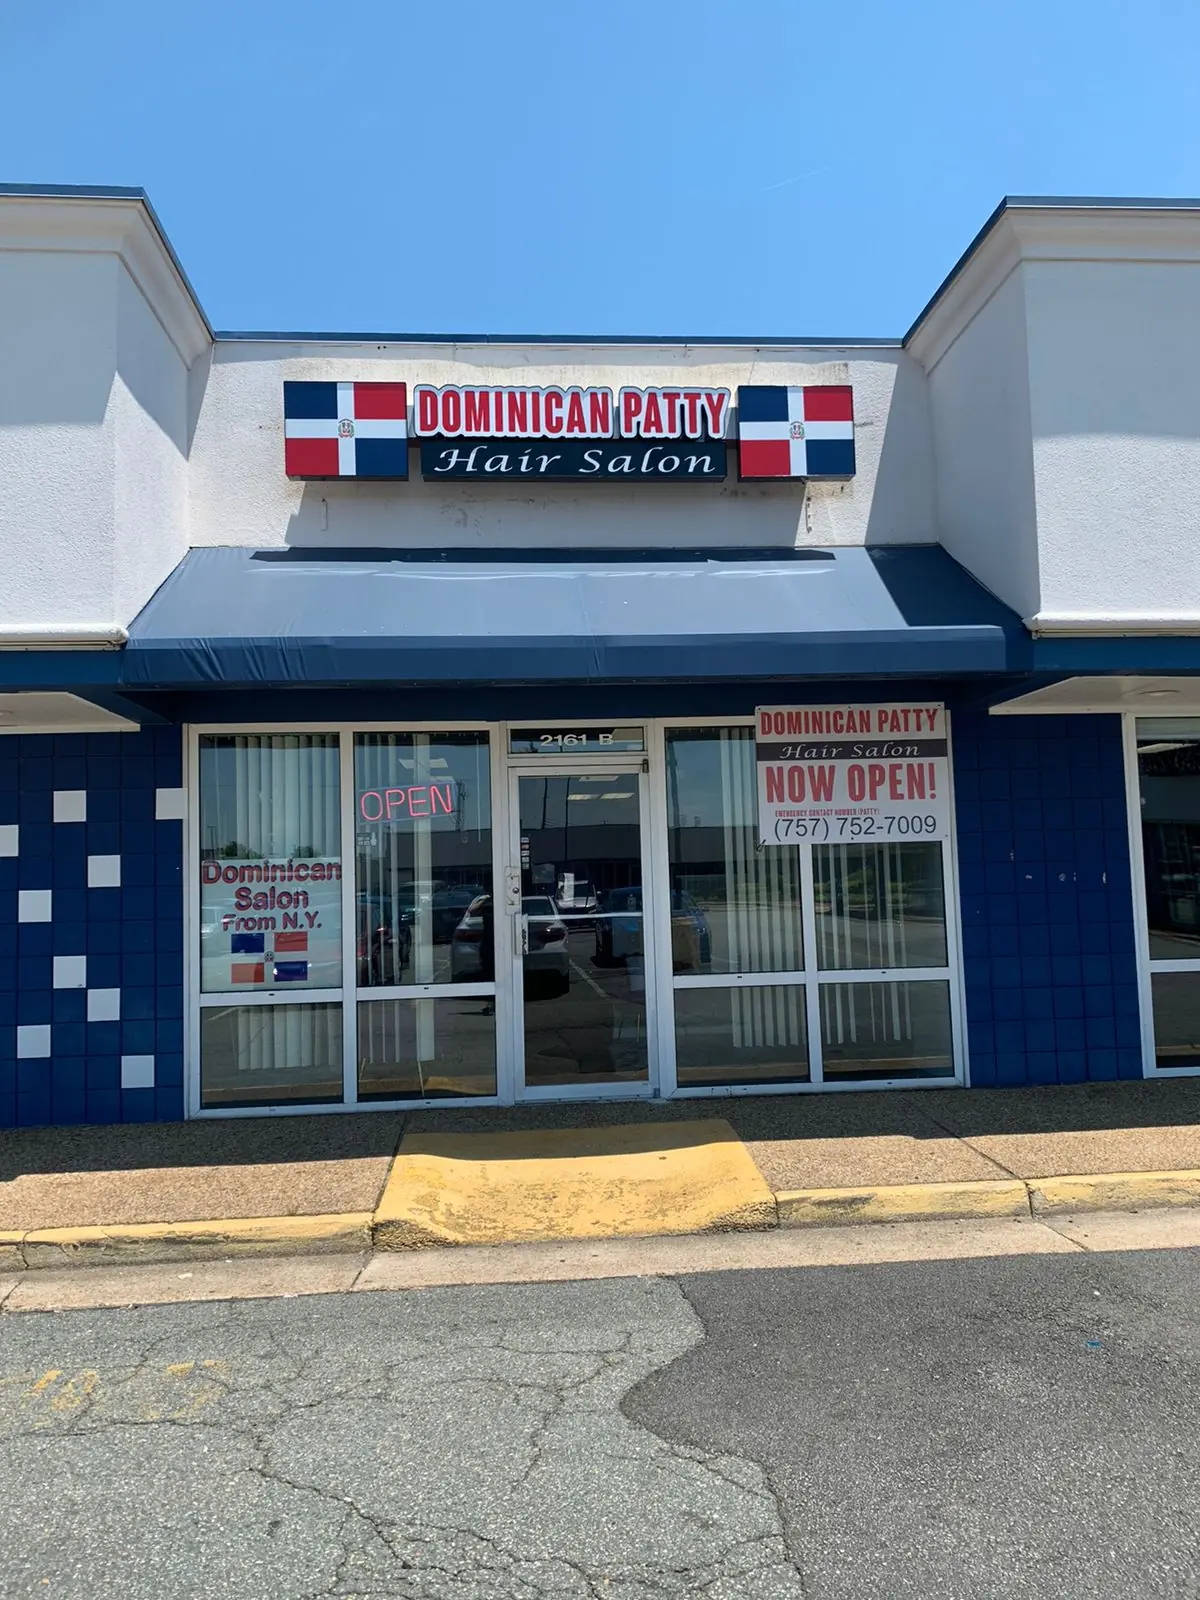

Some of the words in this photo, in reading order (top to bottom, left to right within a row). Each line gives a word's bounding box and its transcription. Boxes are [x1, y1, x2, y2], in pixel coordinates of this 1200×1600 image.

[419, 390, 610, 433] DOMINICAN
[623, 391, 726, 434] PATTY
[434, 445, 562, 473] Hair
[578, 446, 716, 473] Salon
[760, 709, 871, 736] DOMINICAN
[878, 708, 939, 733] PATTY
[540, 733, 588, 747] 2161
[598, 733, 614, 746] B
[779, 743, 843, 759] Hair
[851, 741, 920, 758] Salon
[766, 764, 836, 804] NOW
[847, 762, 937, 802] OPEN!
[360, 783, 452, 821] OPEN
[775, 809, 807, 818] EMERGENCY
[808, 808, 833, 817] CONTACT
[834, 808, 857, 816] NUMBER
[774, 818, 829, 841] (757)
[836, 815, 937, 835] 752-7009
[202, 859, 342, 884] Dominican
[234, 886, 309, 911] Salon
[222, 913, 276, 932] From
[282, 911, 322, 930] N.Y.
